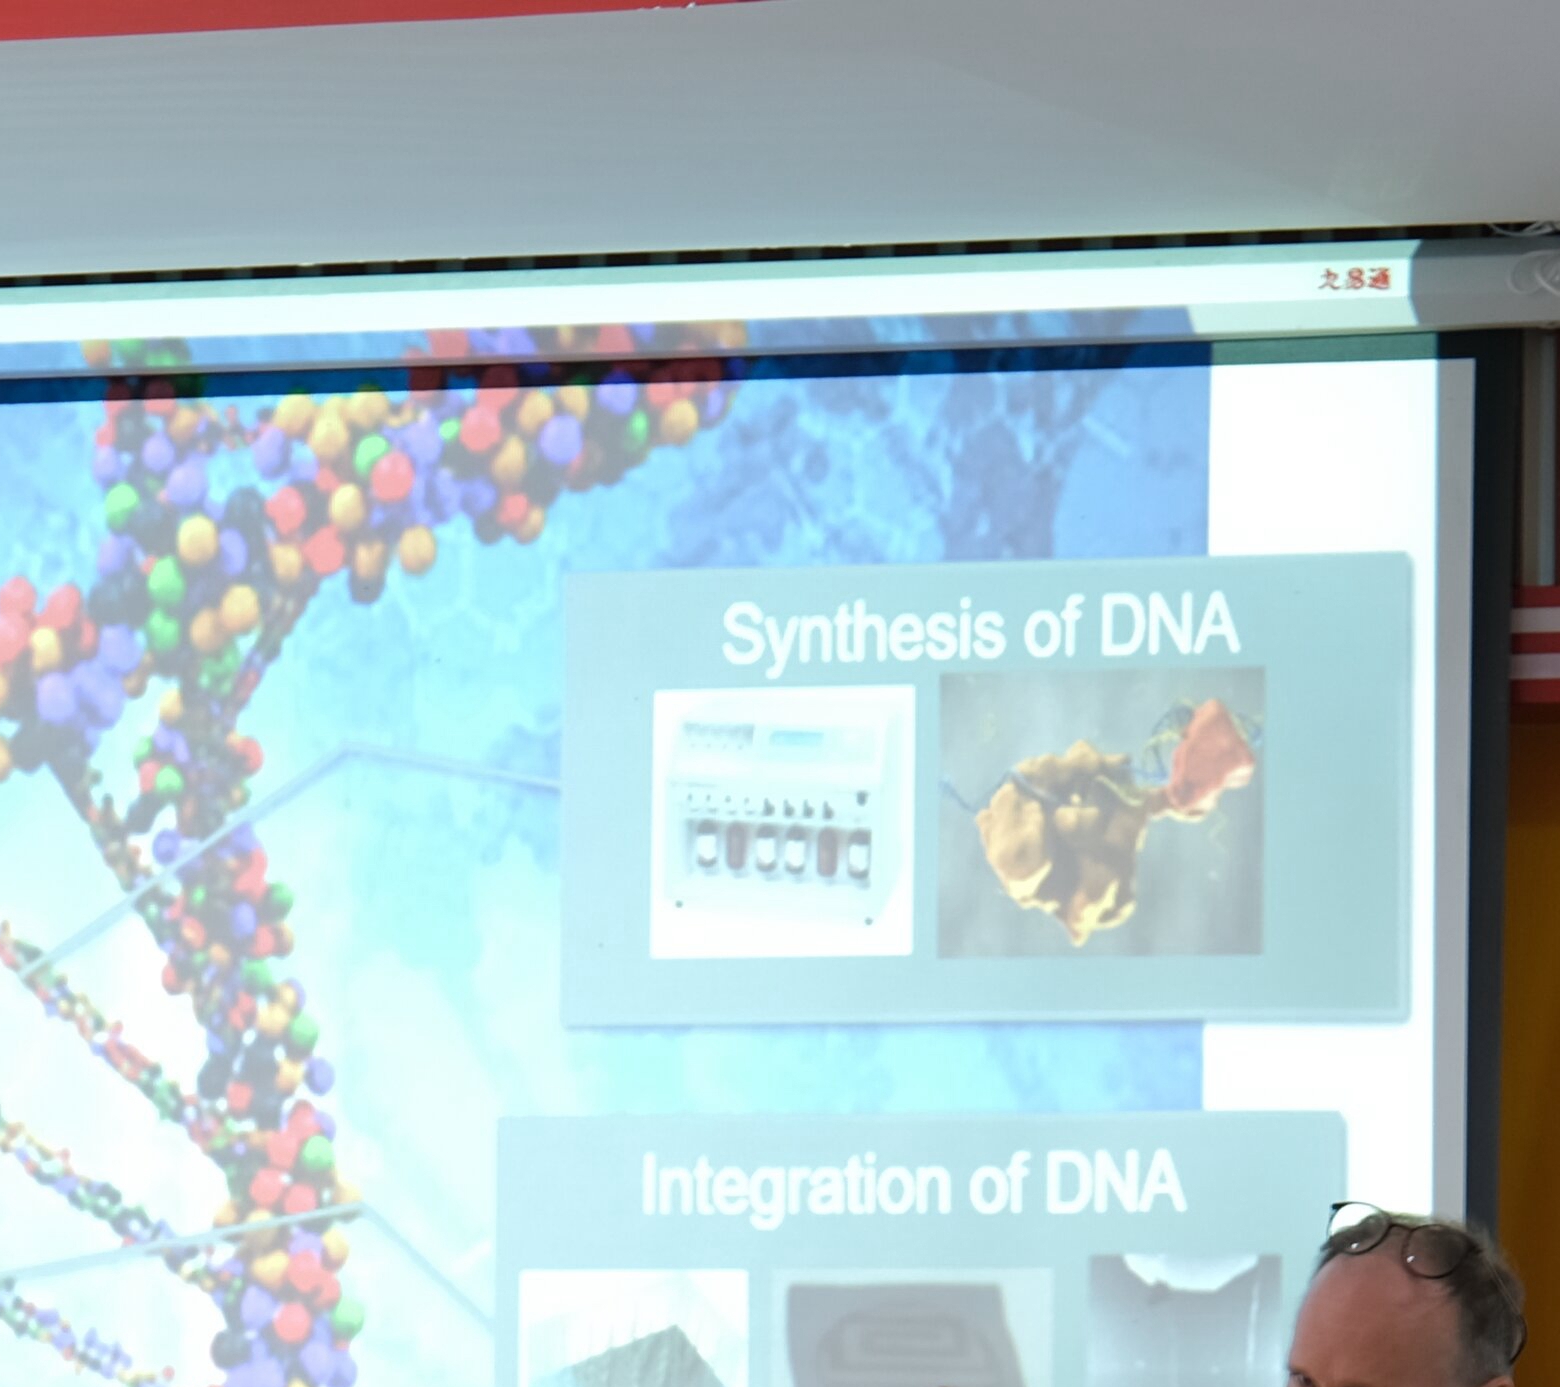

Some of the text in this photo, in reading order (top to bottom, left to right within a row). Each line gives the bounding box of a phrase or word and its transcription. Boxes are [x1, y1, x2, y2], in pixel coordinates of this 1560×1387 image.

[722, 589, 1242, 680] Synthesis of DNA
[642, 1147, 1189, 1232] Integration of DNA
